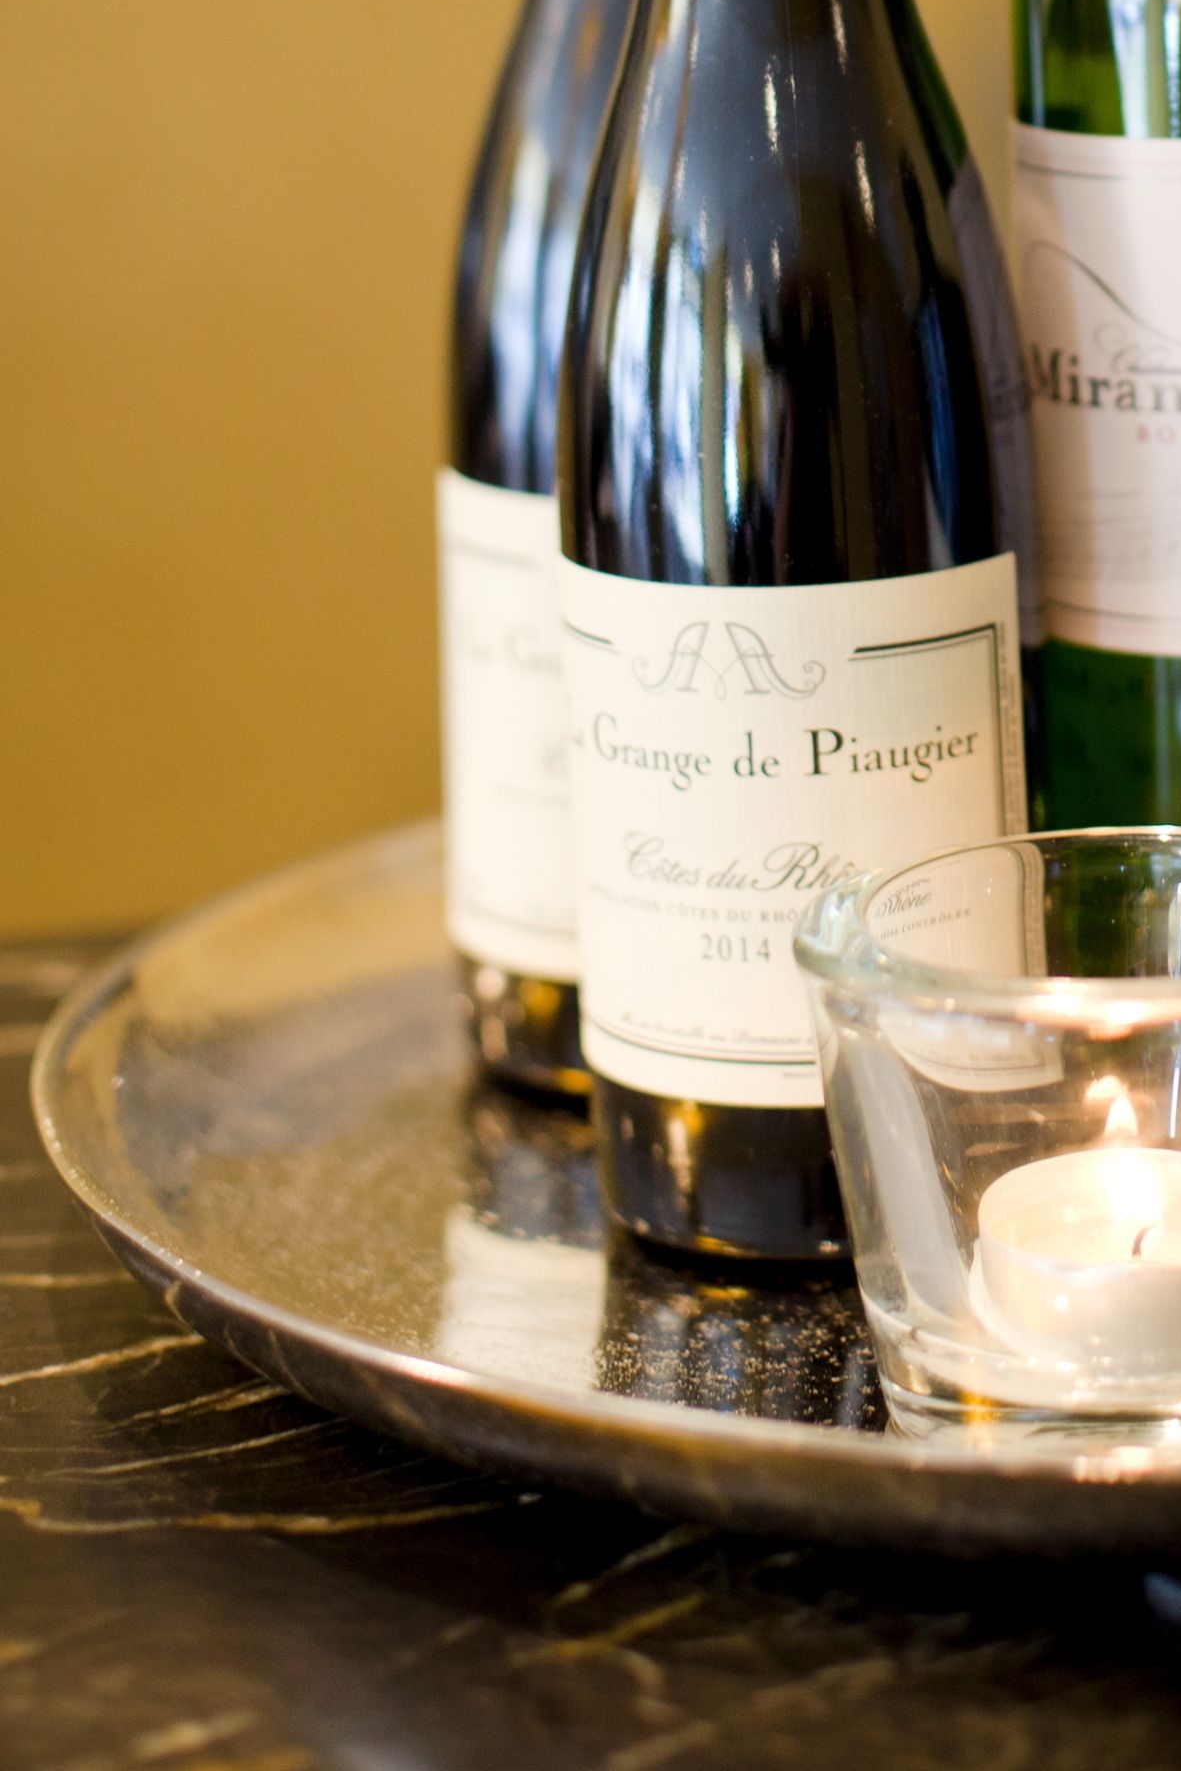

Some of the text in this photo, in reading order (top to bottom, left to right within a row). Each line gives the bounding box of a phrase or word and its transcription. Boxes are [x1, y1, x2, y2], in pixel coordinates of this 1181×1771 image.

[592, 712, 711, 792] Grange
[733, 730, 780, 778] de
[803, 725, 979, 783] Piaugier
[623, 830, 858, 891] Côtes du Rhô
[726, 909, 751, 923] DU
[699, 932, 772, 963] 2014
